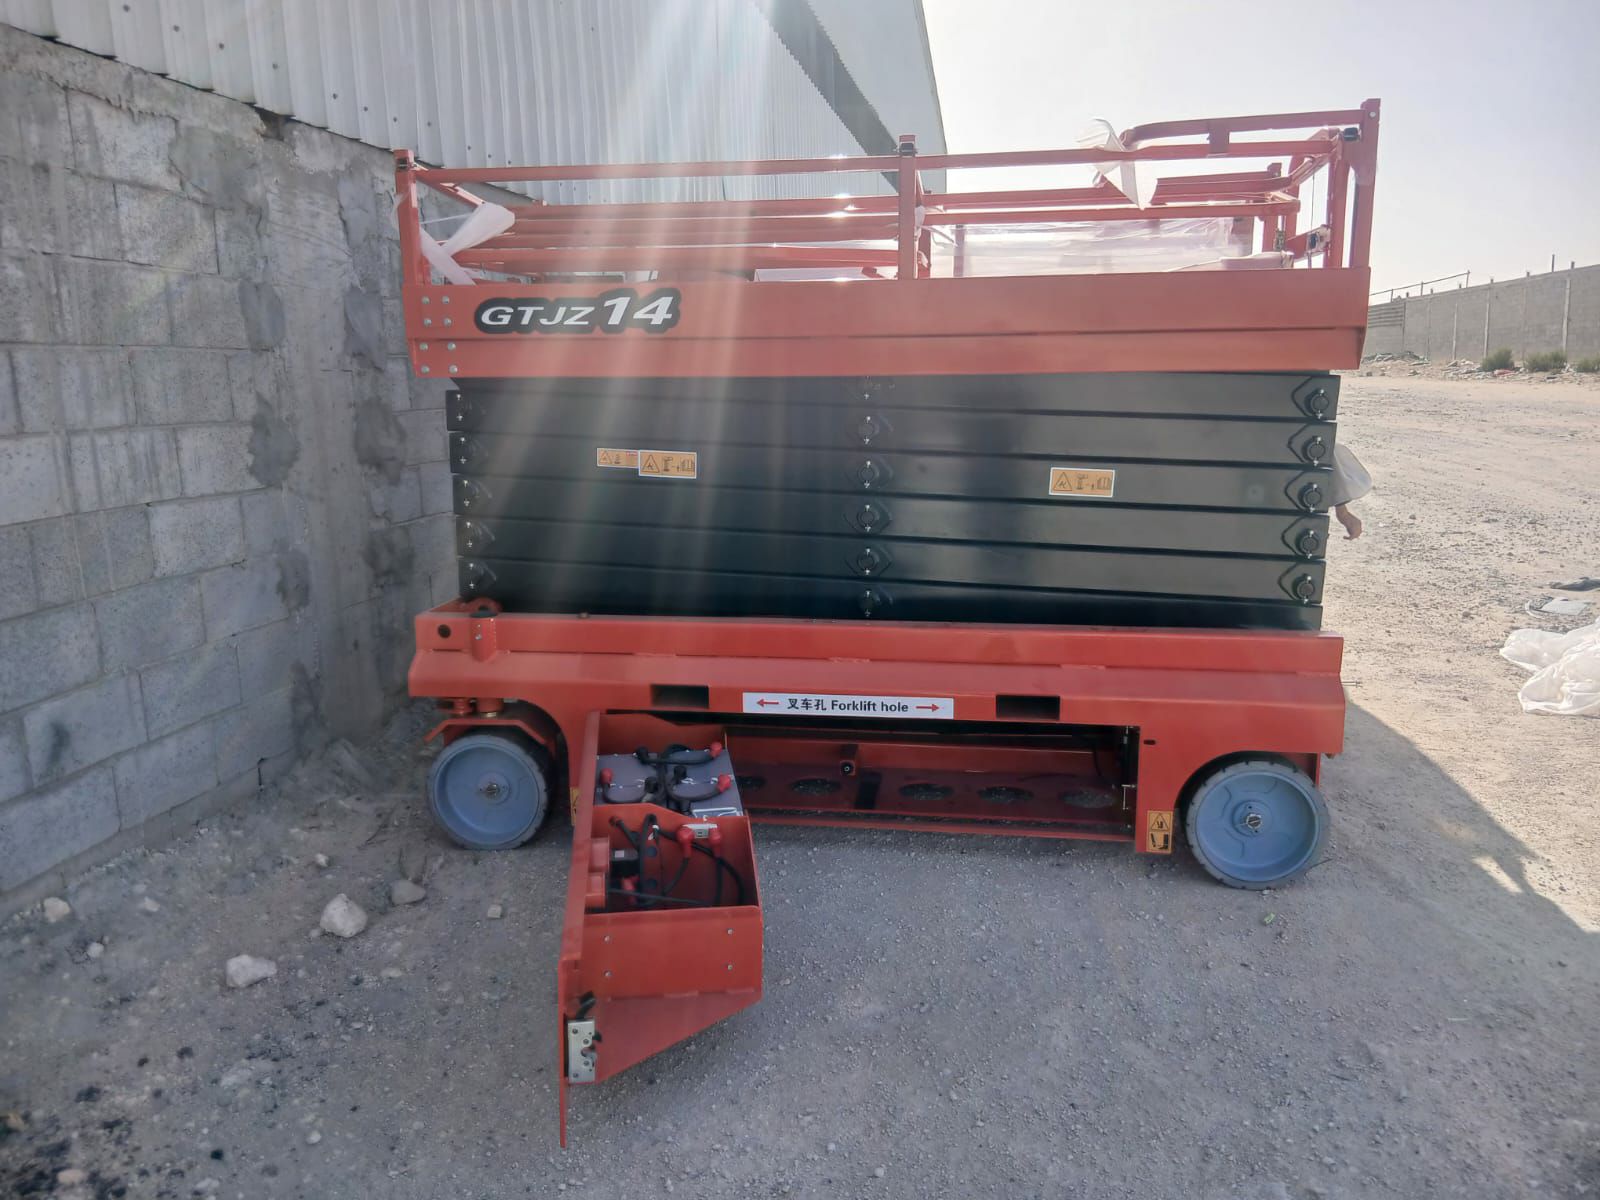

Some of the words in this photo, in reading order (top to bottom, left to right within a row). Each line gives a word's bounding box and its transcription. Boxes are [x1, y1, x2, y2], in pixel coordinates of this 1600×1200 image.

[603, 296, 674, 325] 14
[787, 698, 827, 711] 叉车孔
[831, 699, 877, 712] Forklift
[880, 700, 909, 712] hole
